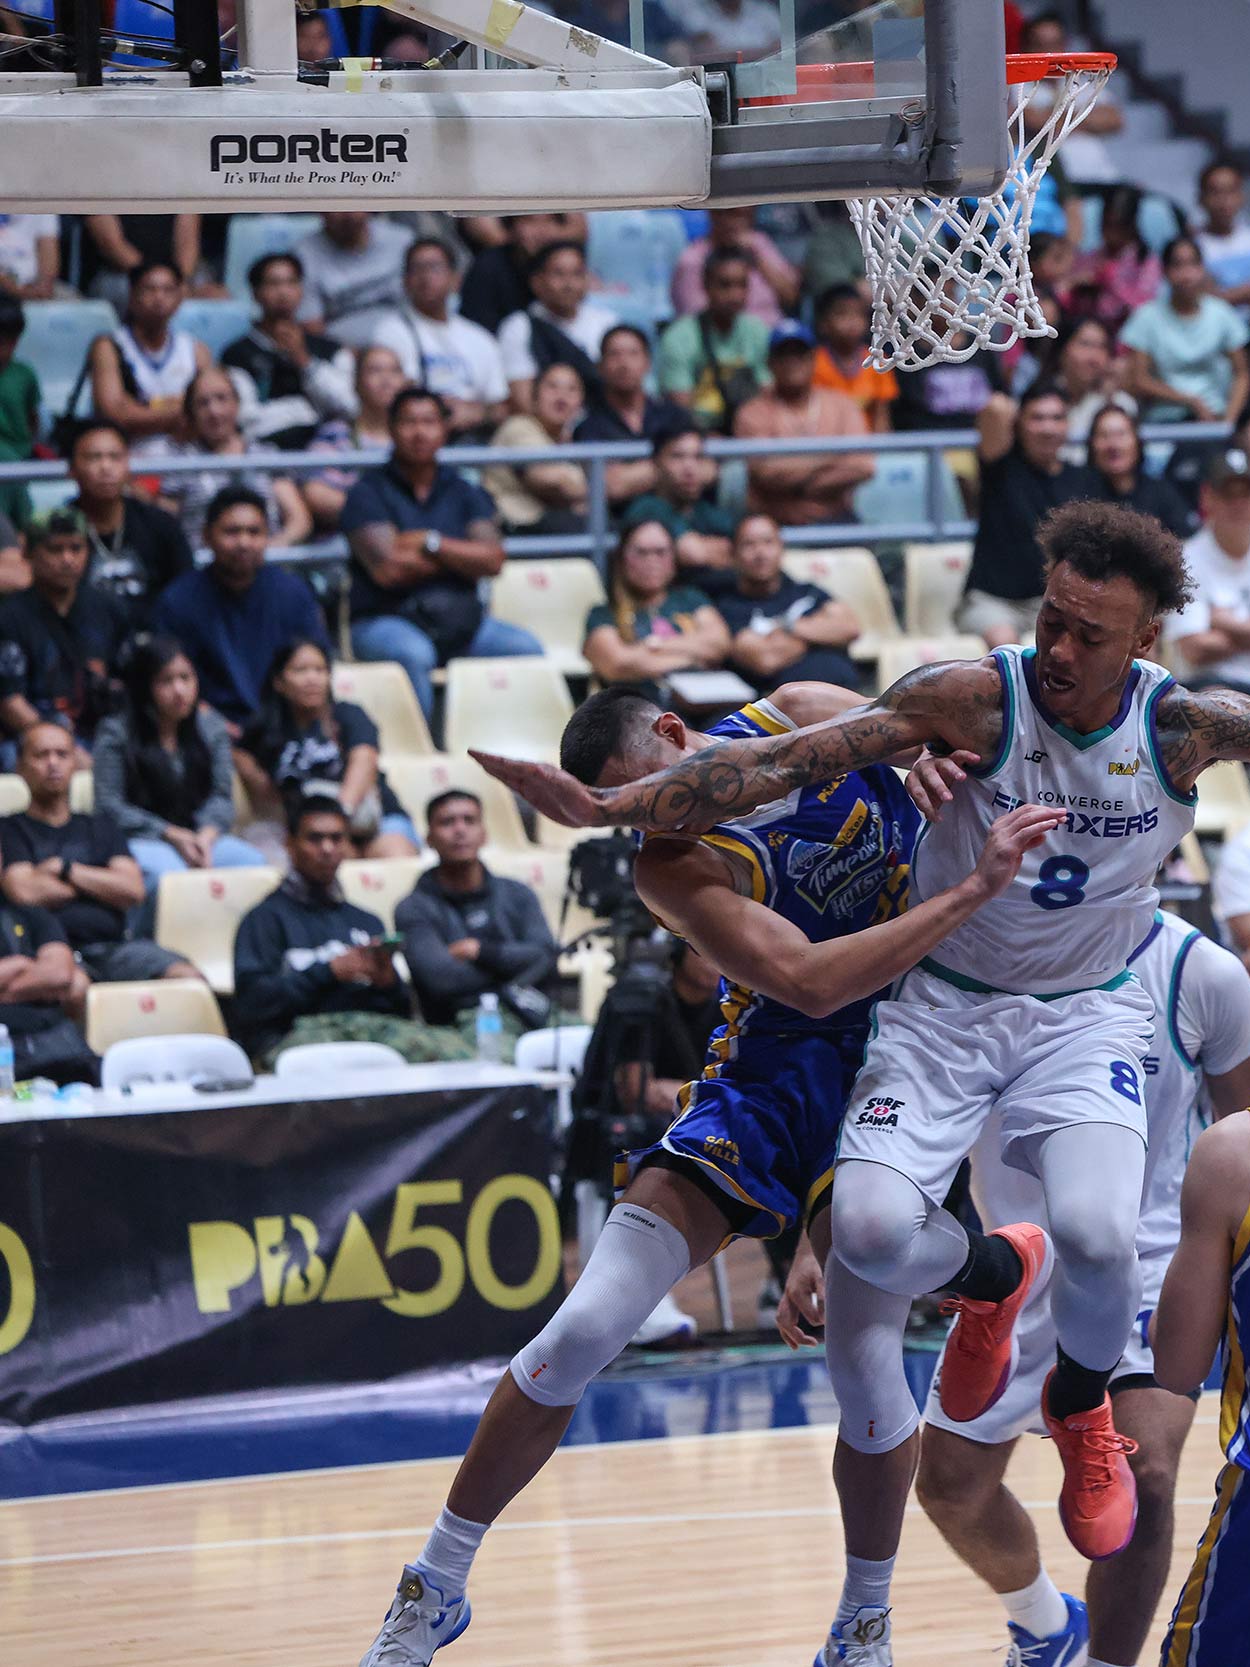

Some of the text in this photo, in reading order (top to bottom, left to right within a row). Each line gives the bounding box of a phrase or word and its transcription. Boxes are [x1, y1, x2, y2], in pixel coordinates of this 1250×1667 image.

[224, 170, 396, 186] It's What the Pros Play On!
[1037, 791, 1124, 812] CONVERGE
[1030, 854, 1090, 910] 8
[1110, 1060, 1141, 1106] 8
[864, 1096, 906, 1110] SURF
[855, 1111, 899, 1127] SAWA
[187, 1173, 563, 1318] PBA50
